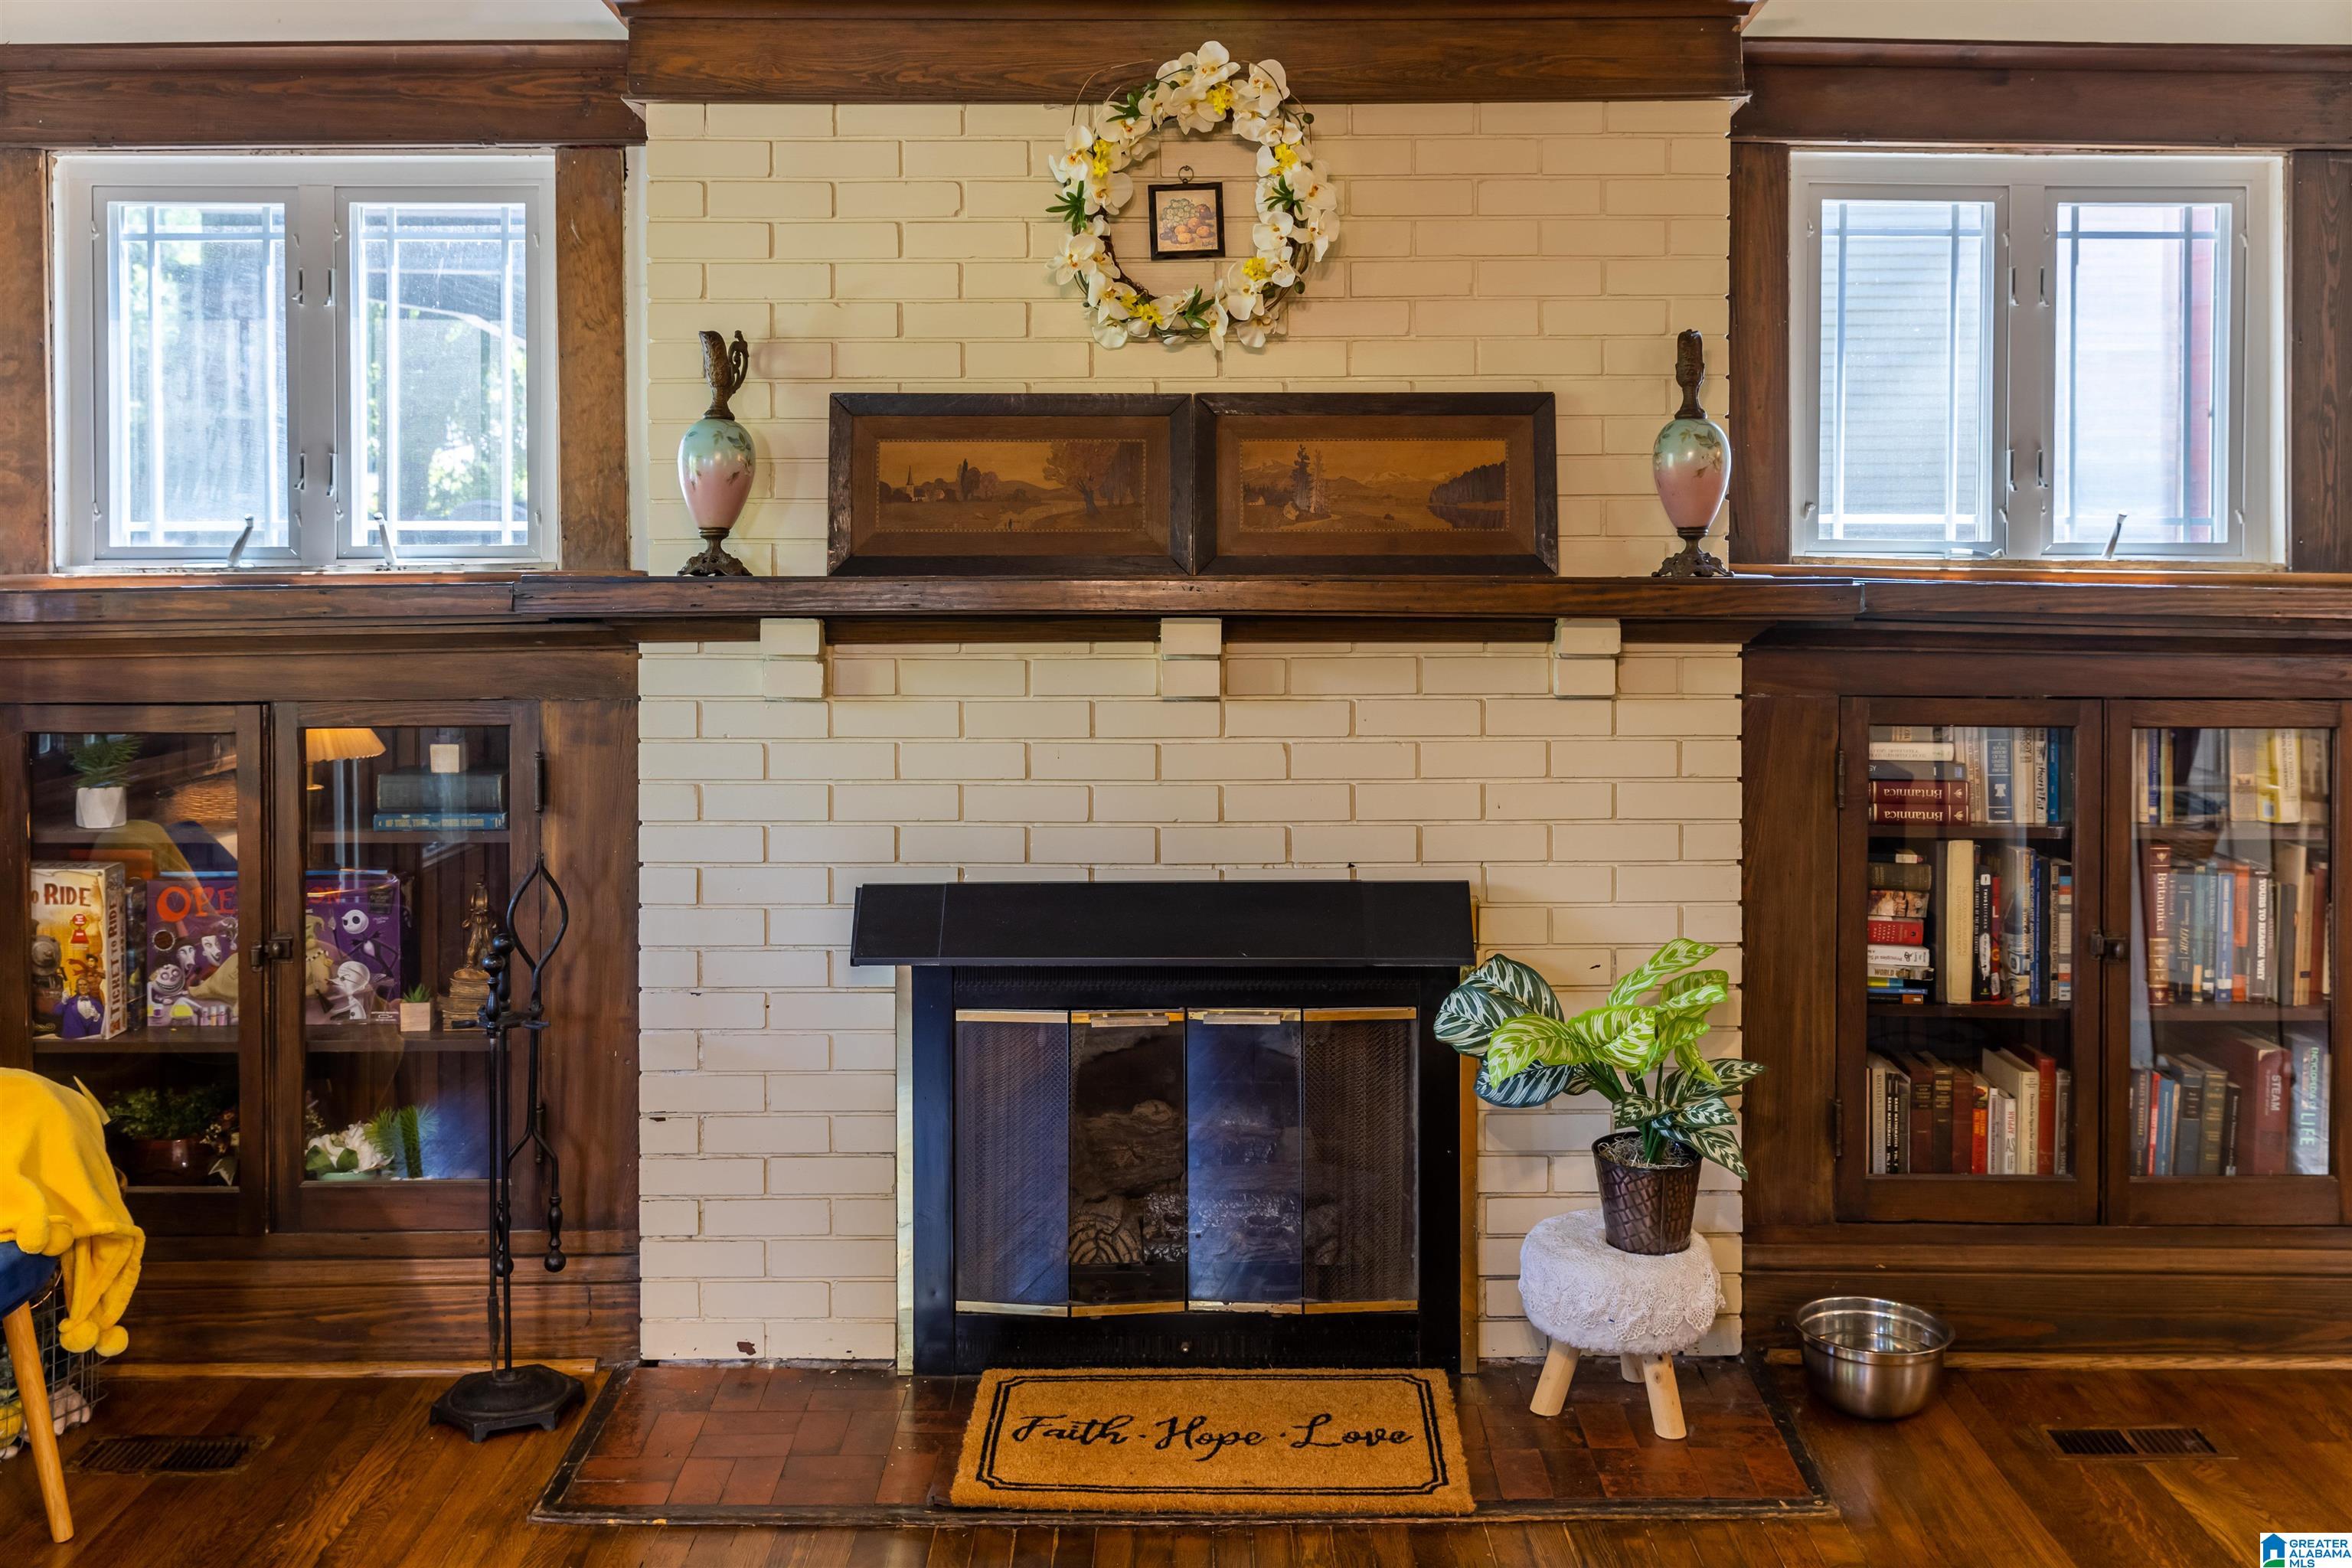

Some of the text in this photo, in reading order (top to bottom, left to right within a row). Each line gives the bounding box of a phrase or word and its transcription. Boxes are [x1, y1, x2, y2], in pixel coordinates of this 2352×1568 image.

[1884, 789, 1942, 799] Britannica
[2037, 766, 2046, 810] Heart Fist
[1884, 811, 1943, 821] Britannica
[44, 883, 91, 906] RIDE
[2156, 872, 2167, 932] Britannica
[2179, 927, 2189, 955] LOGIC
[2256, 878, 2267, 981] YOURS TO REASON WHY
[108, 901, 121, 1017] TICKET TO RIDE
[1874, 969, 1893, 977] WORLD
[2309, 1047, 2319, 1099] ENCYCLOPEDIA
[2270, 1074, 2282, 1111] STEAM
[2300, 1112, 2317, 1146] LIFE
[1012, 1413, 1414, 1462] Faith Hope Love
